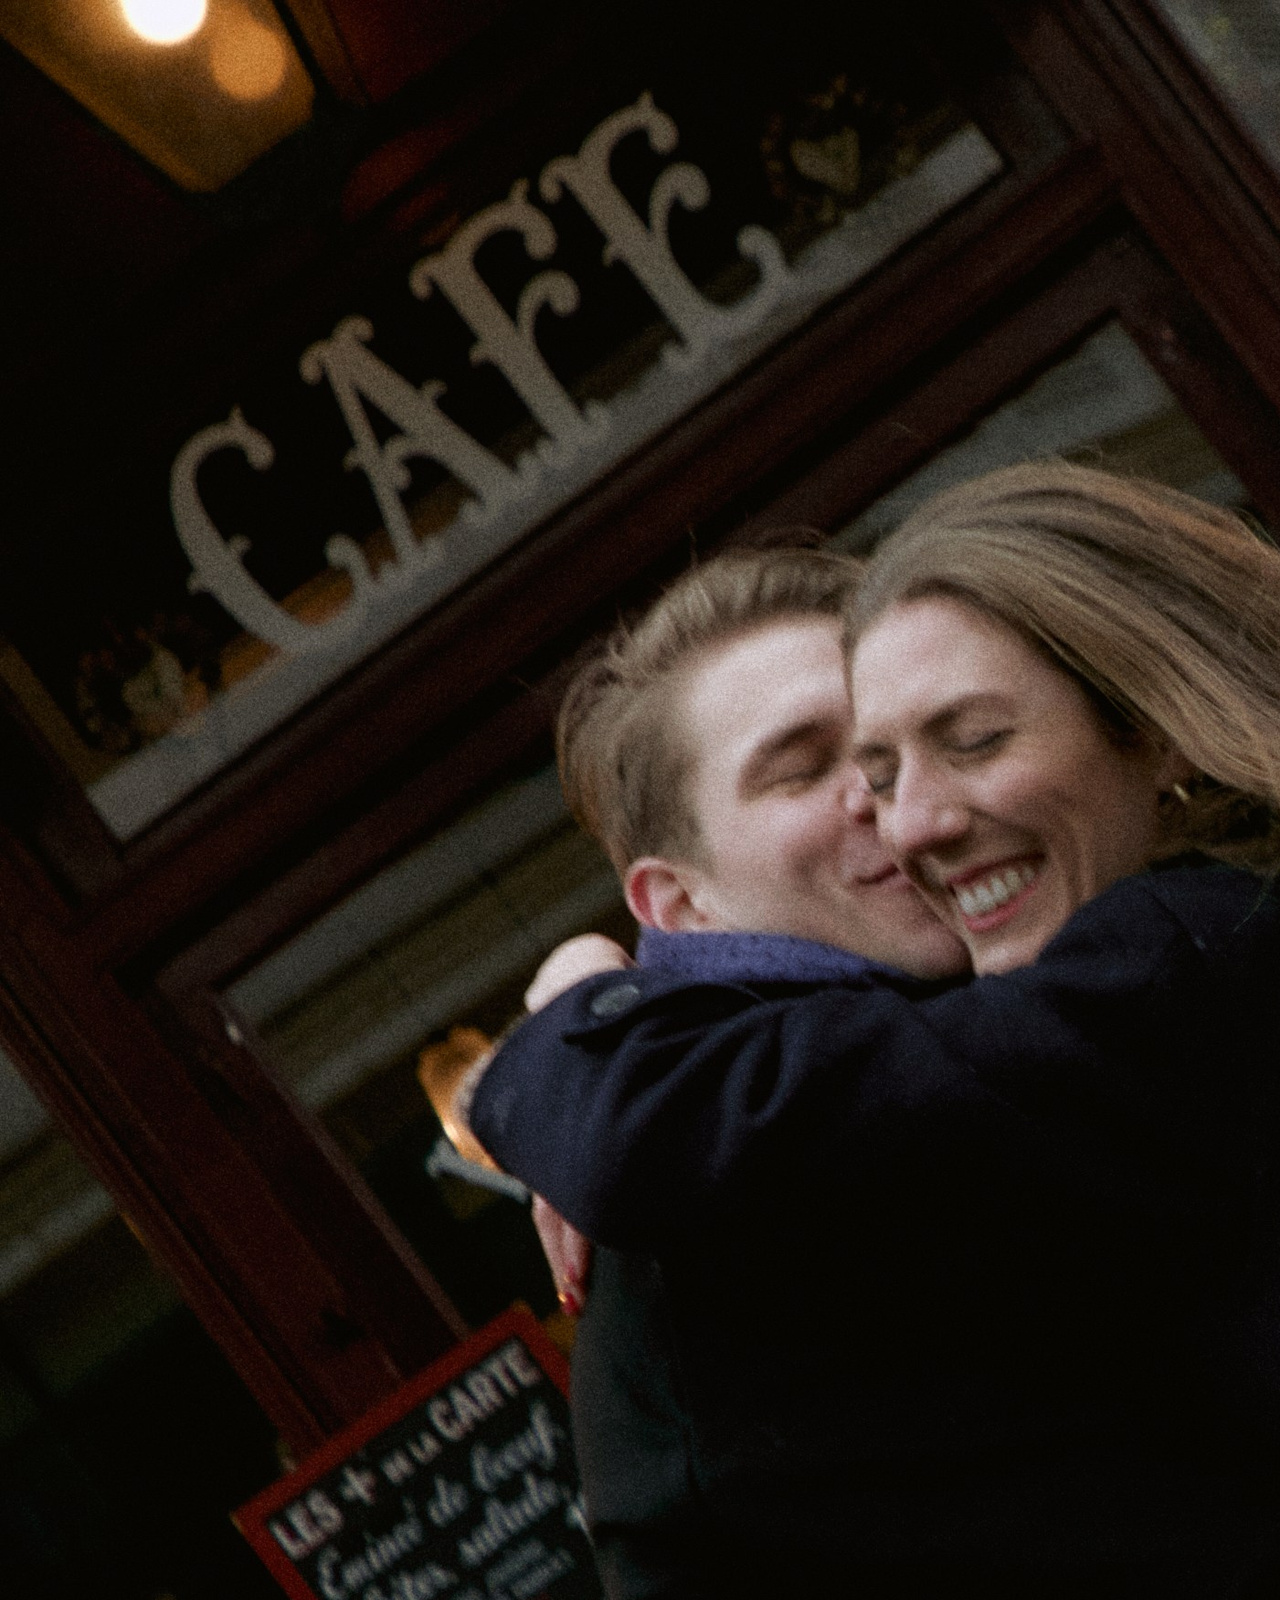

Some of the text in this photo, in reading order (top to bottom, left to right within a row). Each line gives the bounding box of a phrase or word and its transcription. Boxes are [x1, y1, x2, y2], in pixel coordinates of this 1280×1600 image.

[168, 88, 798, 662] CAFE
[267, 1490, 345, 1562] LES
[427, 1337, 544, 1444] CARTE
